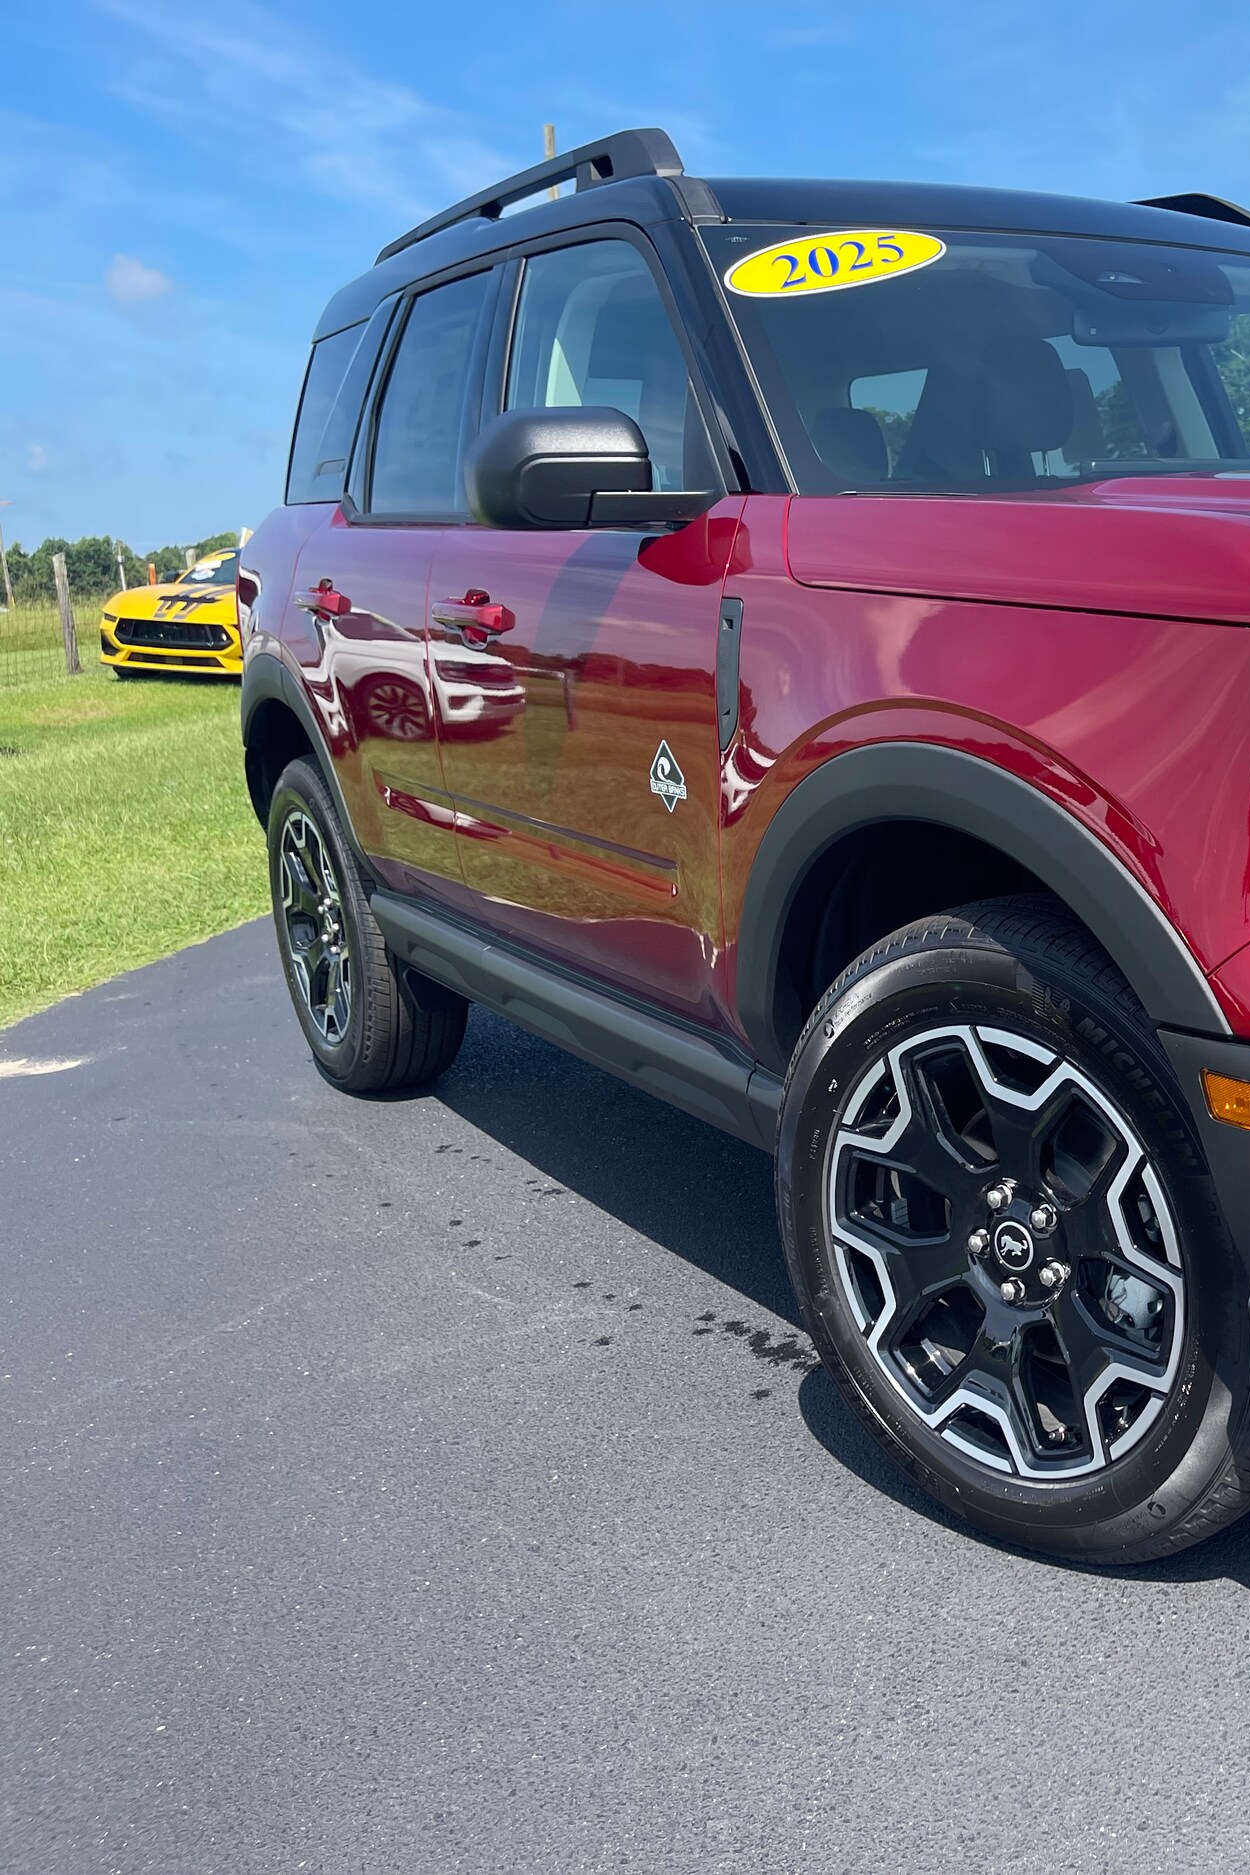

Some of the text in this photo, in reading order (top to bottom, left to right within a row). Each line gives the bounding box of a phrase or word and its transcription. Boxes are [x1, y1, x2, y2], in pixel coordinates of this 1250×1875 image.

[771, 235, 905, 289] 2025
[652, 782, 685, 796] OUTER BANKS
[1076, 1017, 1199, 1166] MICHELIN
